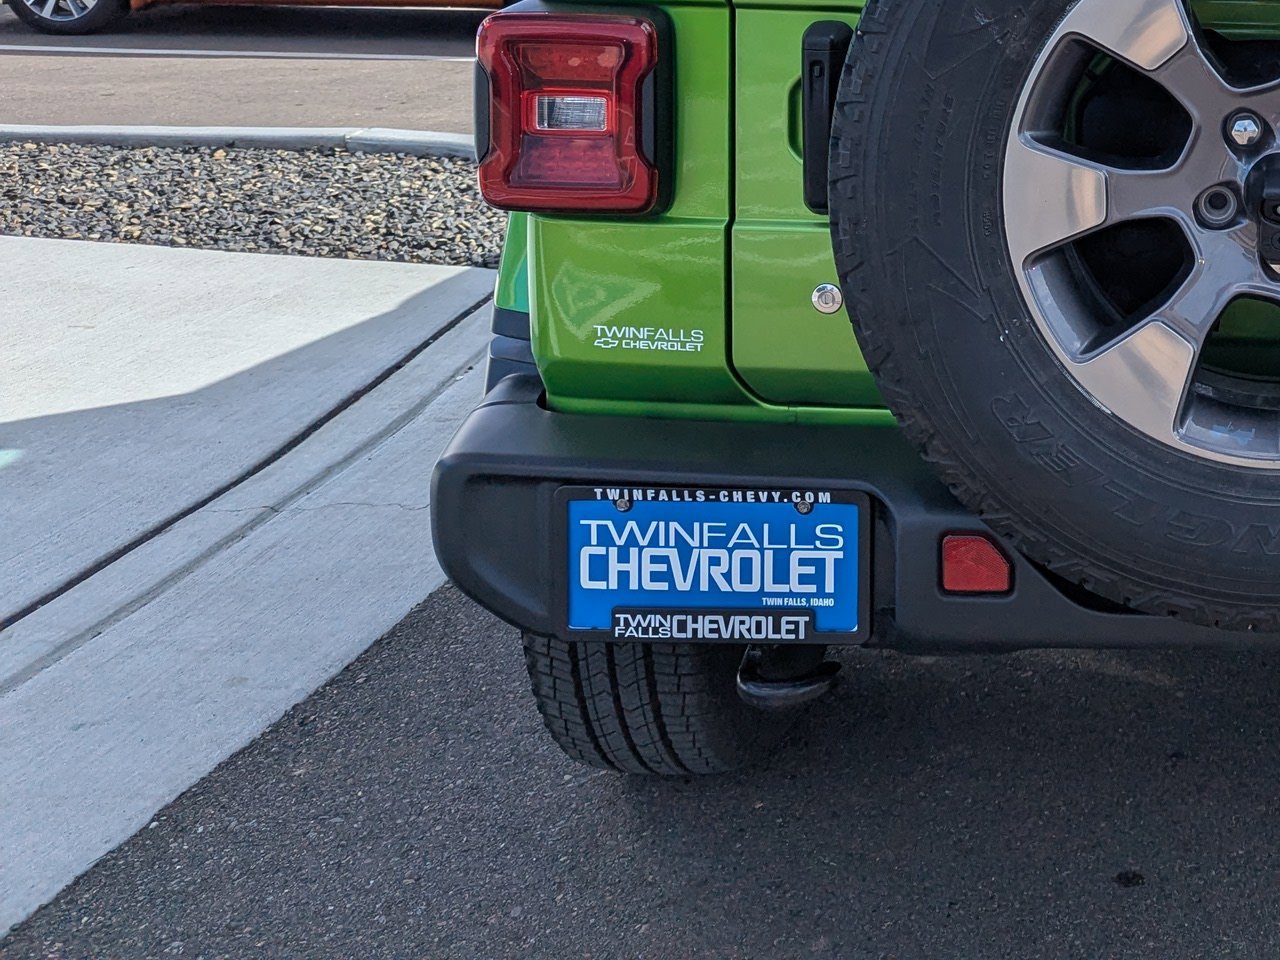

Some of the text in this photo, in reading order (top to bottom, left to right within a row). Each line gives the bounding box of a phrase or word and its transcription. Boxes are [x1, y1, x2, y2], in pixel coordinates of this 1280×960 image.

[593, 325, 704, 341] TWINFALLS
[621, 340, 704, 352] CHEVROLET
[594, 488, 831, 503] TWINFALLS-CHEVY.COM
[580, 520, 844, 549] TWINFALLS
[579, 546, 844, 593] CHEVROLET
[762, 597, 835, 607] TWIN FALLS, IDAHO
[614, 615, 810, 639] FALLS CHEVROLET
[615, 614, 671, 627] TWIN
